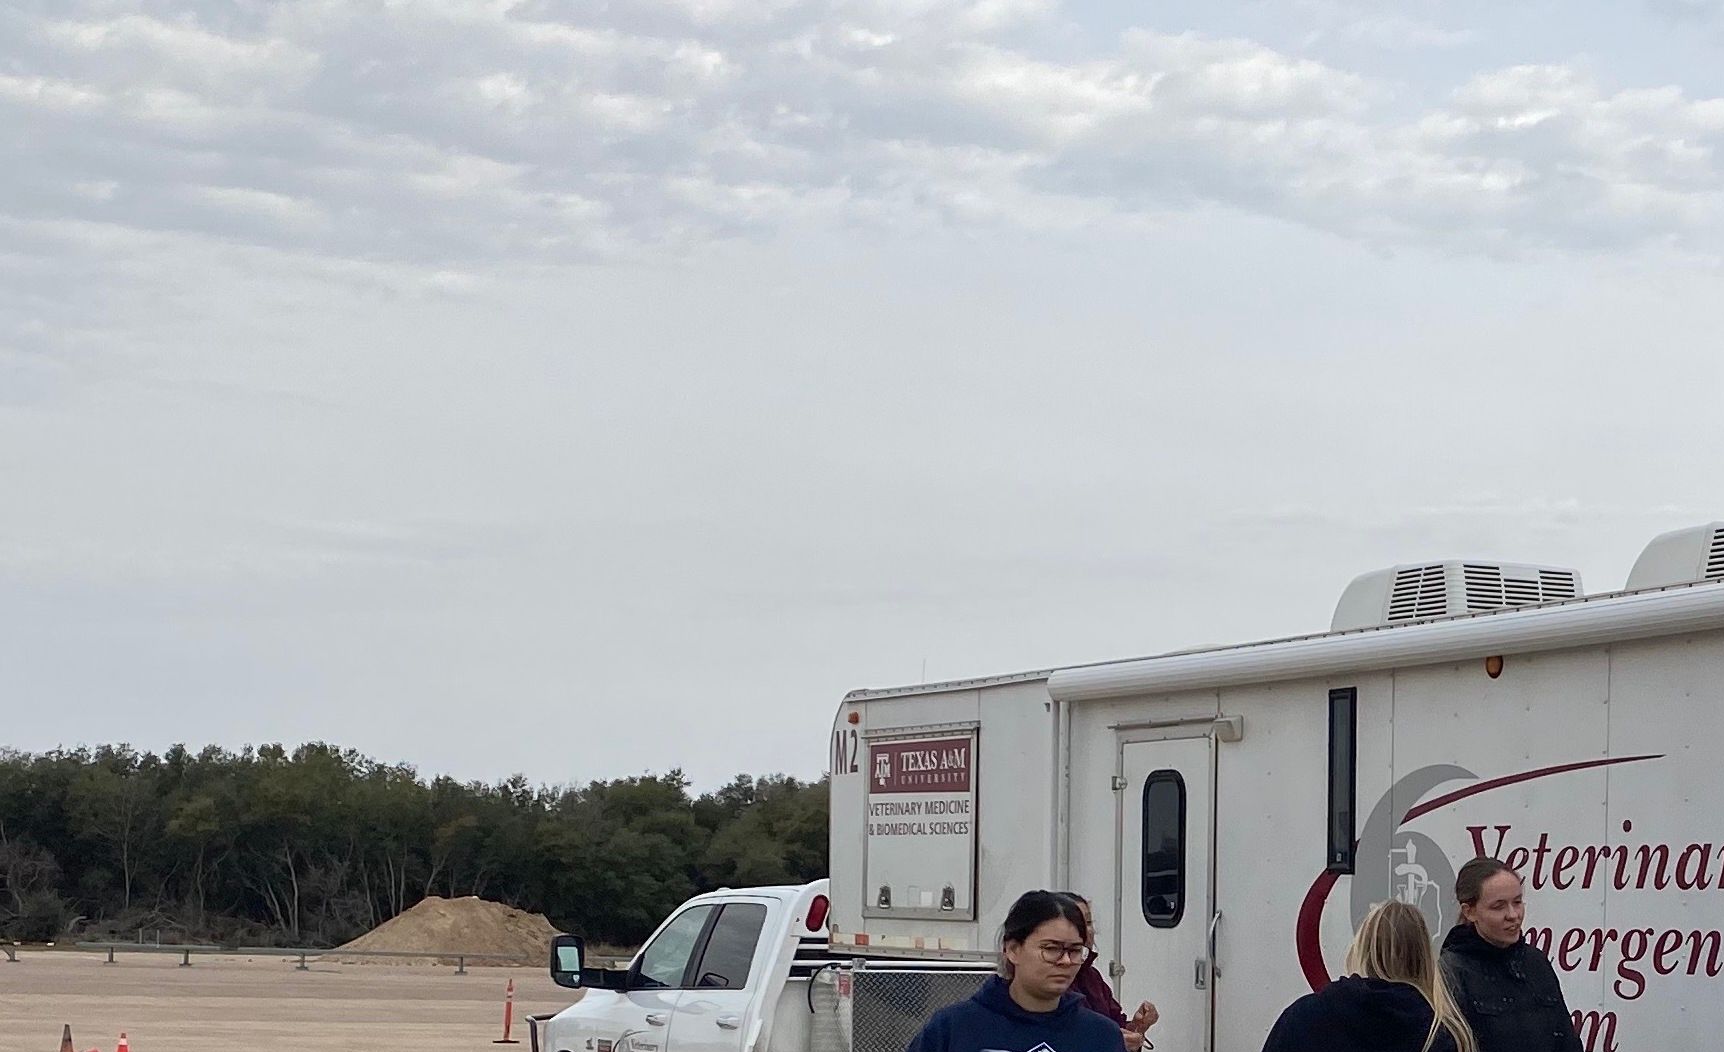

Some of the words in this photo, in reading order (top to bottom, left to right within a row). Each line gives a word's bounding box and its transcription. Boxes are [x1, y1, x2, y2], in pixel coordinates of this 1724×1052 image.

[835, 729, 858, 775] M2
[901, 750, 938, 771] TEXAS
[940, 747, 966, 770] A&M
[901, 772, 965, 785] UNIVERSITY
[869, 801, 922, 816] VETERINARY
[925, 799, 970, 815] MEDICINE
[869, 823, 875, 836] &
[877, 822, 928, 836] BIOMEDICAL
[929, 821, 969, 836] SCIENCES
